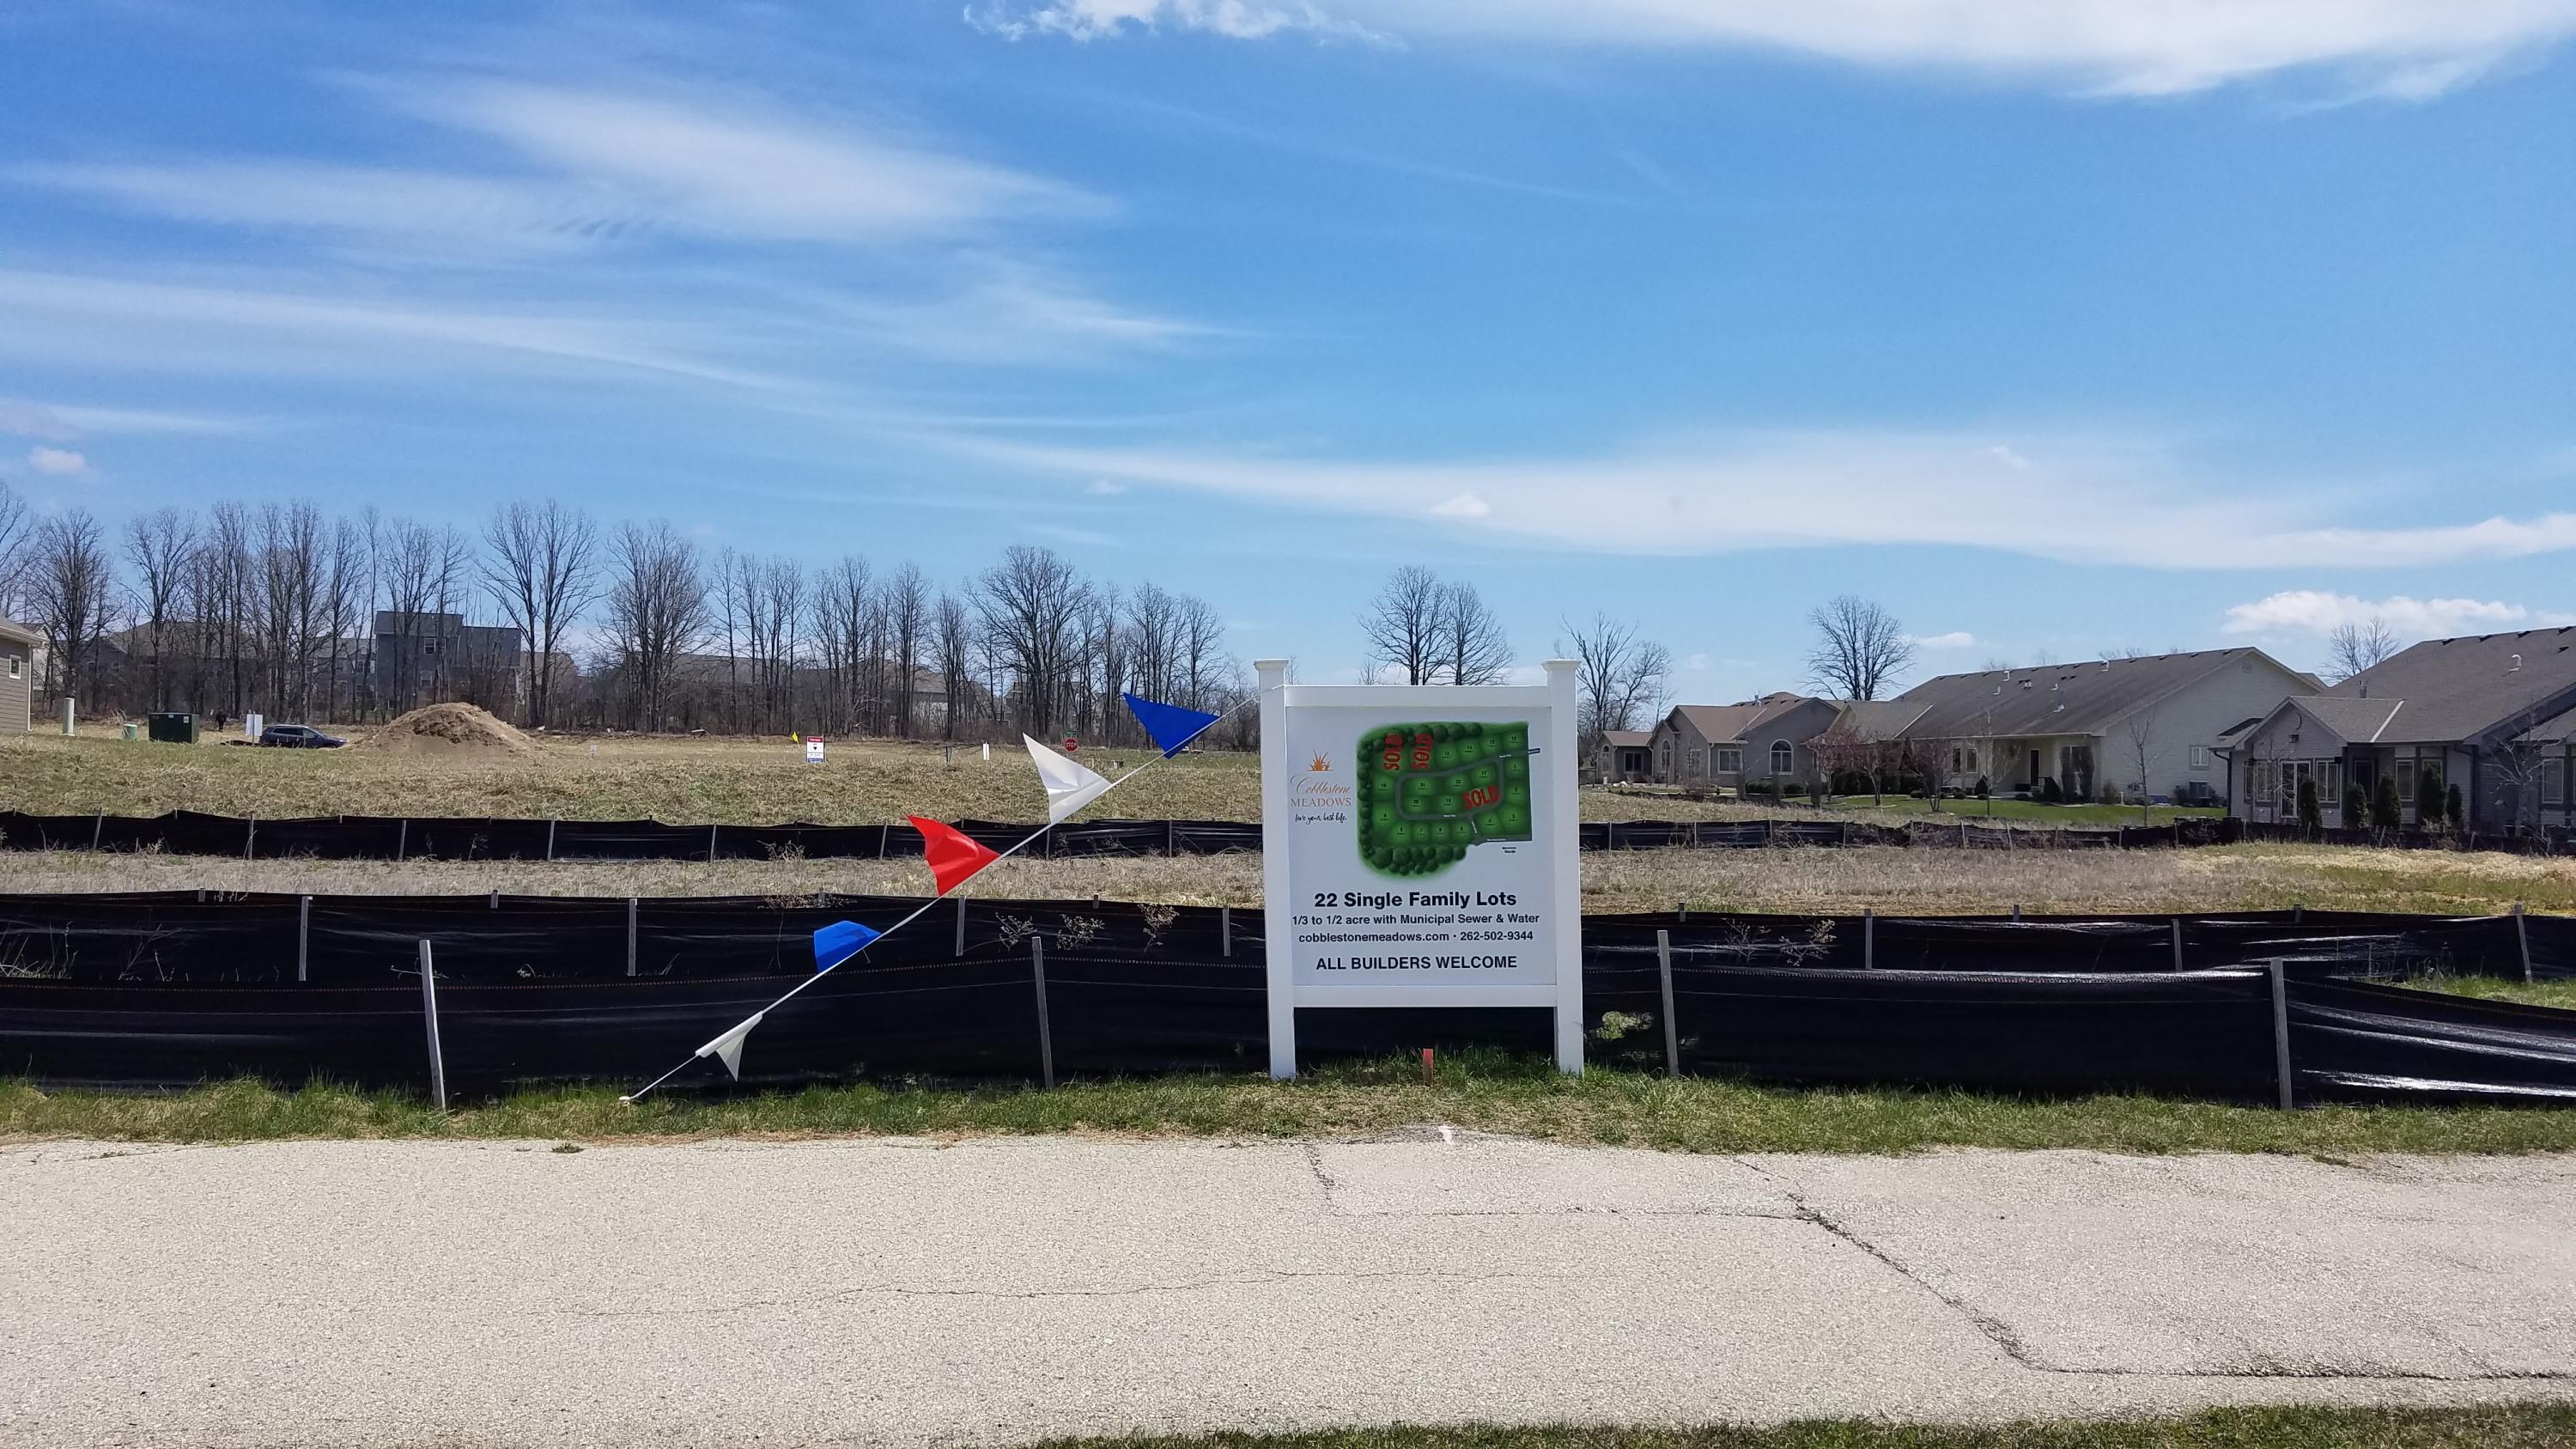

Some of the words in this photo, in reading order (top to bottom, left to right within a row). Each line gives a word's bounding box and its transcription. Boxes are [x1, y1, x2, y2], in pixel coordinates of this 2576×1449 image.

[1383, 734, 1402, 770] SOLD
[1412, 734, 1432, 770] SOLD
[1291, 776, 1351, 795] Cobblestone
[1291, 798, 1352, 807] MEADOWS
[1462, 784, 1498, 809] SOLD
[1306, 815, 1321, 825] your
[1323, 812, 1335, 821] best
[1315, 892, 1338, 907] 22
[1344, 892, 1402, 910] Single
[1409, 892, 1470, 909] Family
[1476, 891, 1516, 906] Lots
[1292, 916, 1309, 925] 1/3
[1311, 916, 1322, 925] to
[1327, 915, 1342, 924] 1/2
[1374, 914, 1397, 924] with
[1400, 914, 1455, 926] Municipal
[1457, 914, 1492, 923] Sewer
[1496, 913, 1504, 923] &
[1507, 913, 1540, 923] Water
[1298, 932, 1449, 942] cobblestonemeadows.com
[1460, 931, 1534, 941] 262-502-9344
[1316, 958, 1346, 970] ALL
[1351, 956, 1431, 970] BUILDERS
[1435, 956, 1518, 969] WELCOME
